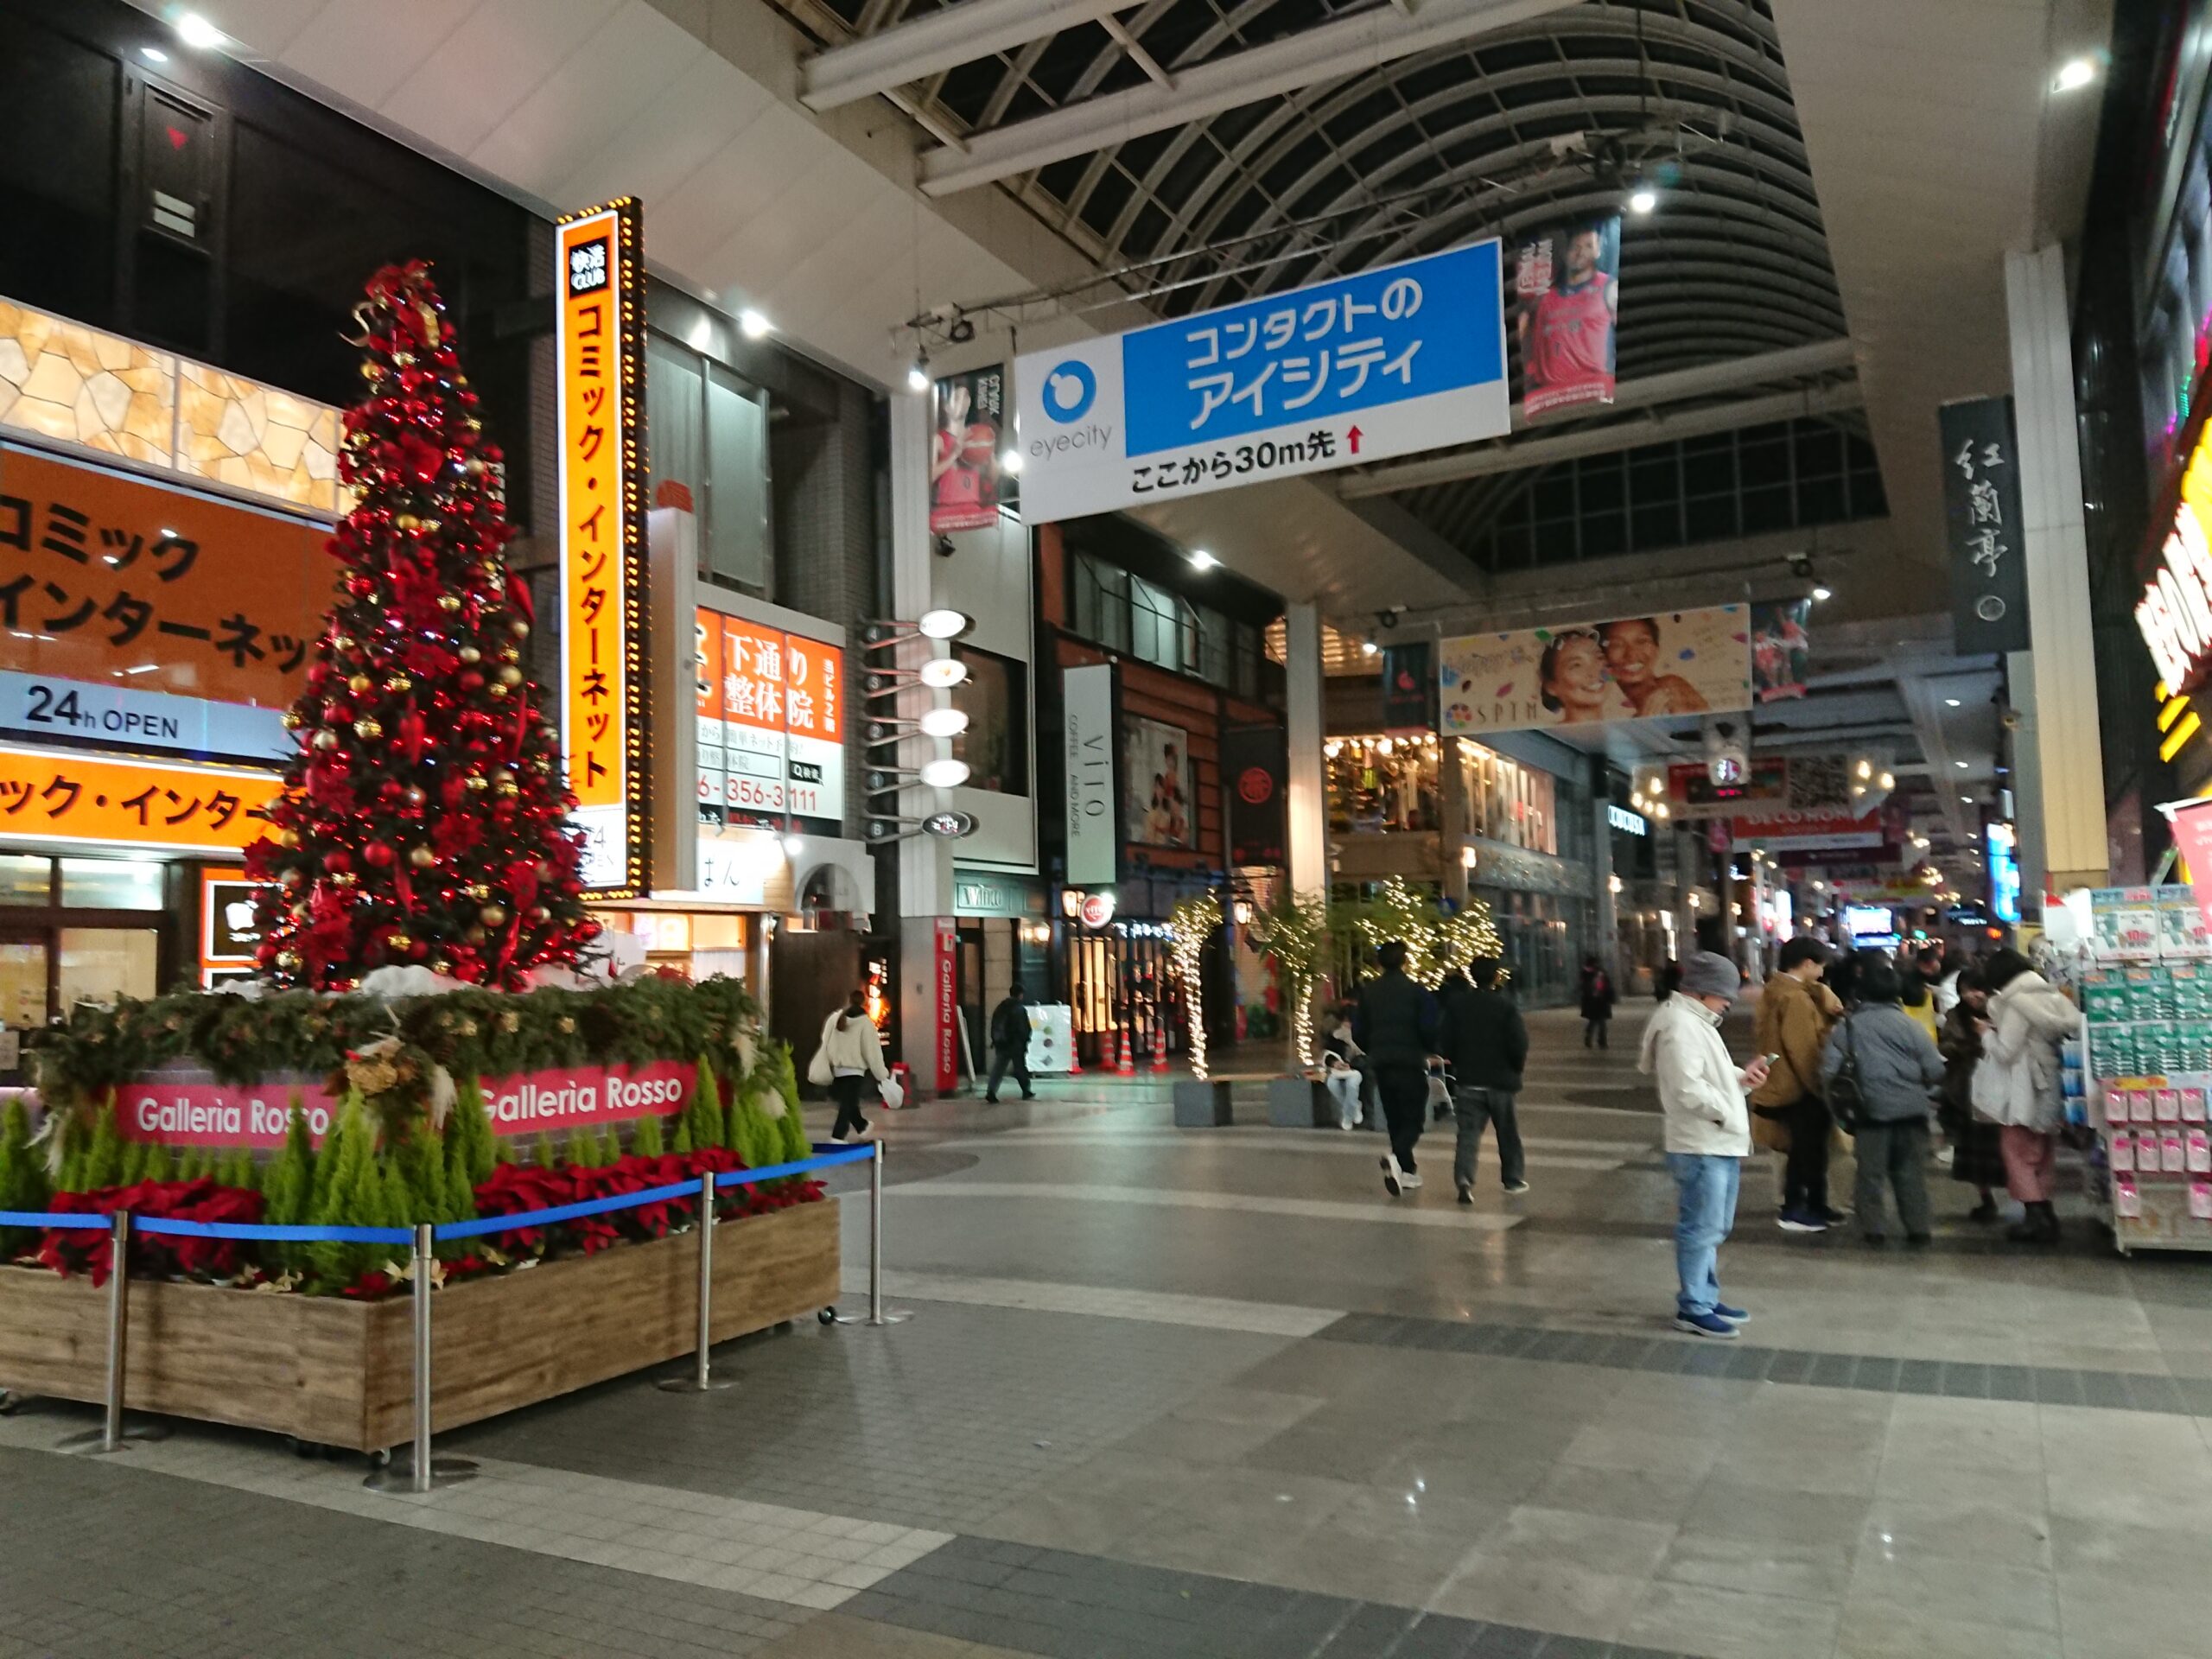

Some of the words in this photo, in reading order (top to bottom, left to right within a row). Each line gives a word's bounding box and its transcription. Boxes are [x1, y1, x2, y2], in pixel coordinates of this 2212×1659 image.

[571, 267, 606, 290] CLUB
[1186, 277, 1423, 370] コンタクトの
[1187, 337, 1424, 430] アイシティ
[1030, 423, 1113, 460] eyecity
[1131, 430, 1336, 494] ここから30m先
[0, 494, 200, 582] コミック
[578, 304, 609, 788] コミック・インターネット
[724, 631, 808, 685] 下通り
[103, 709, 179, 740] OPEN
[723, 671, 814, 729] 整体院
[251, 1099, 330, 1135] Roso
[607, 1077, 683, 1109] Rosso
